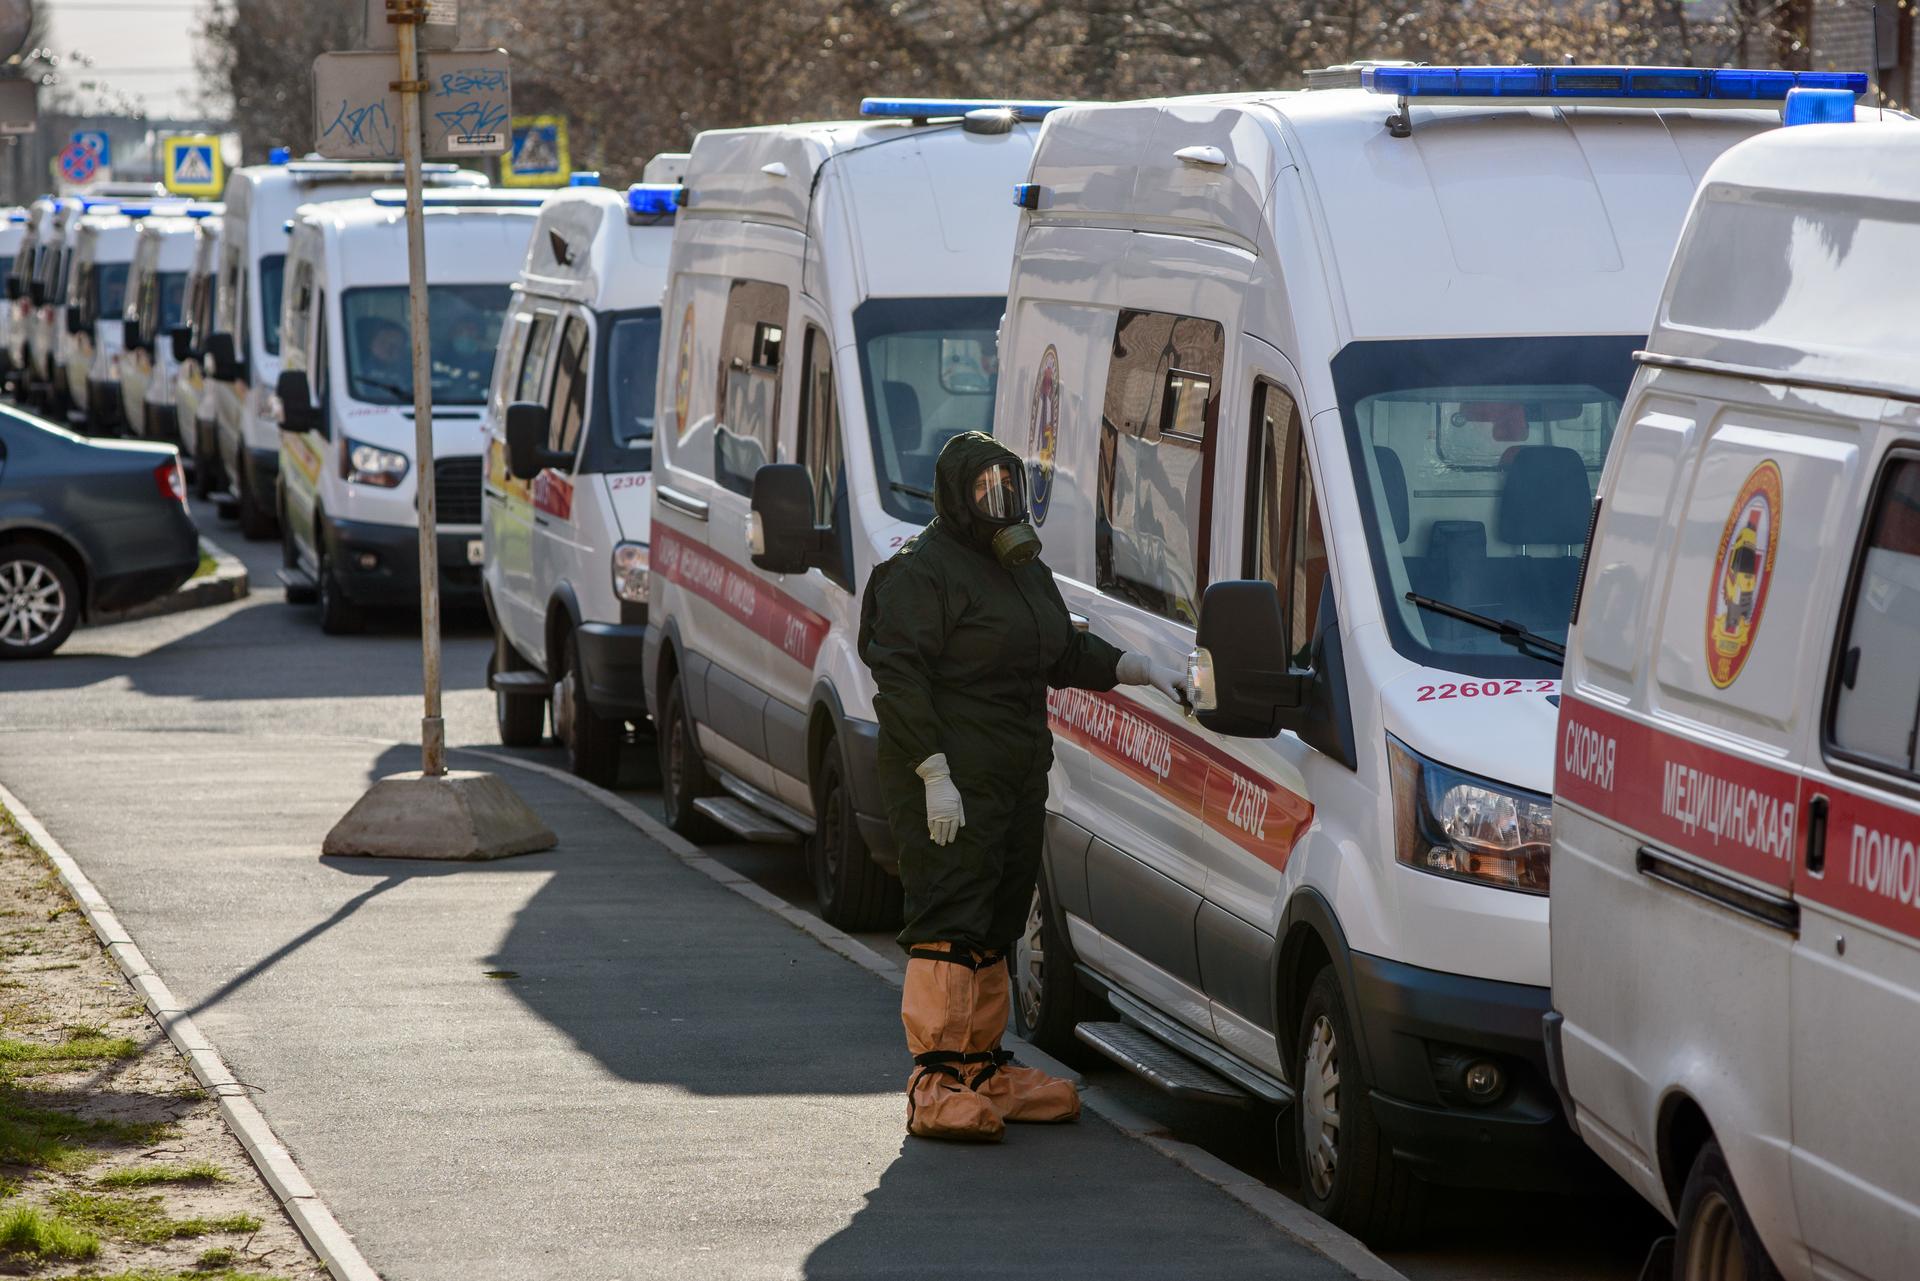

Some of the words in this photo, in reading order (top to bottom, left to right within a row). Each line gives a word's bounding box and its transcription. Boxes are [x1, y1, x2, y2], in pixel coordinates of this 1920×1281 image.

[612, 474, 652, 491] 230
[1416, 680, 1555, 702] 22602.2
[1046, 686, 1116, 745] ЕДИЦИНСКАЯ
[1117, 711, 1172, 784] ПОМОЩЬ
[1227, 773, 1269, 841] 22602
[1565, 719, 1616, 793] СКОРАЯ
[1662, 760, 1795, 862] МЕДИЦИНСКАЯ
